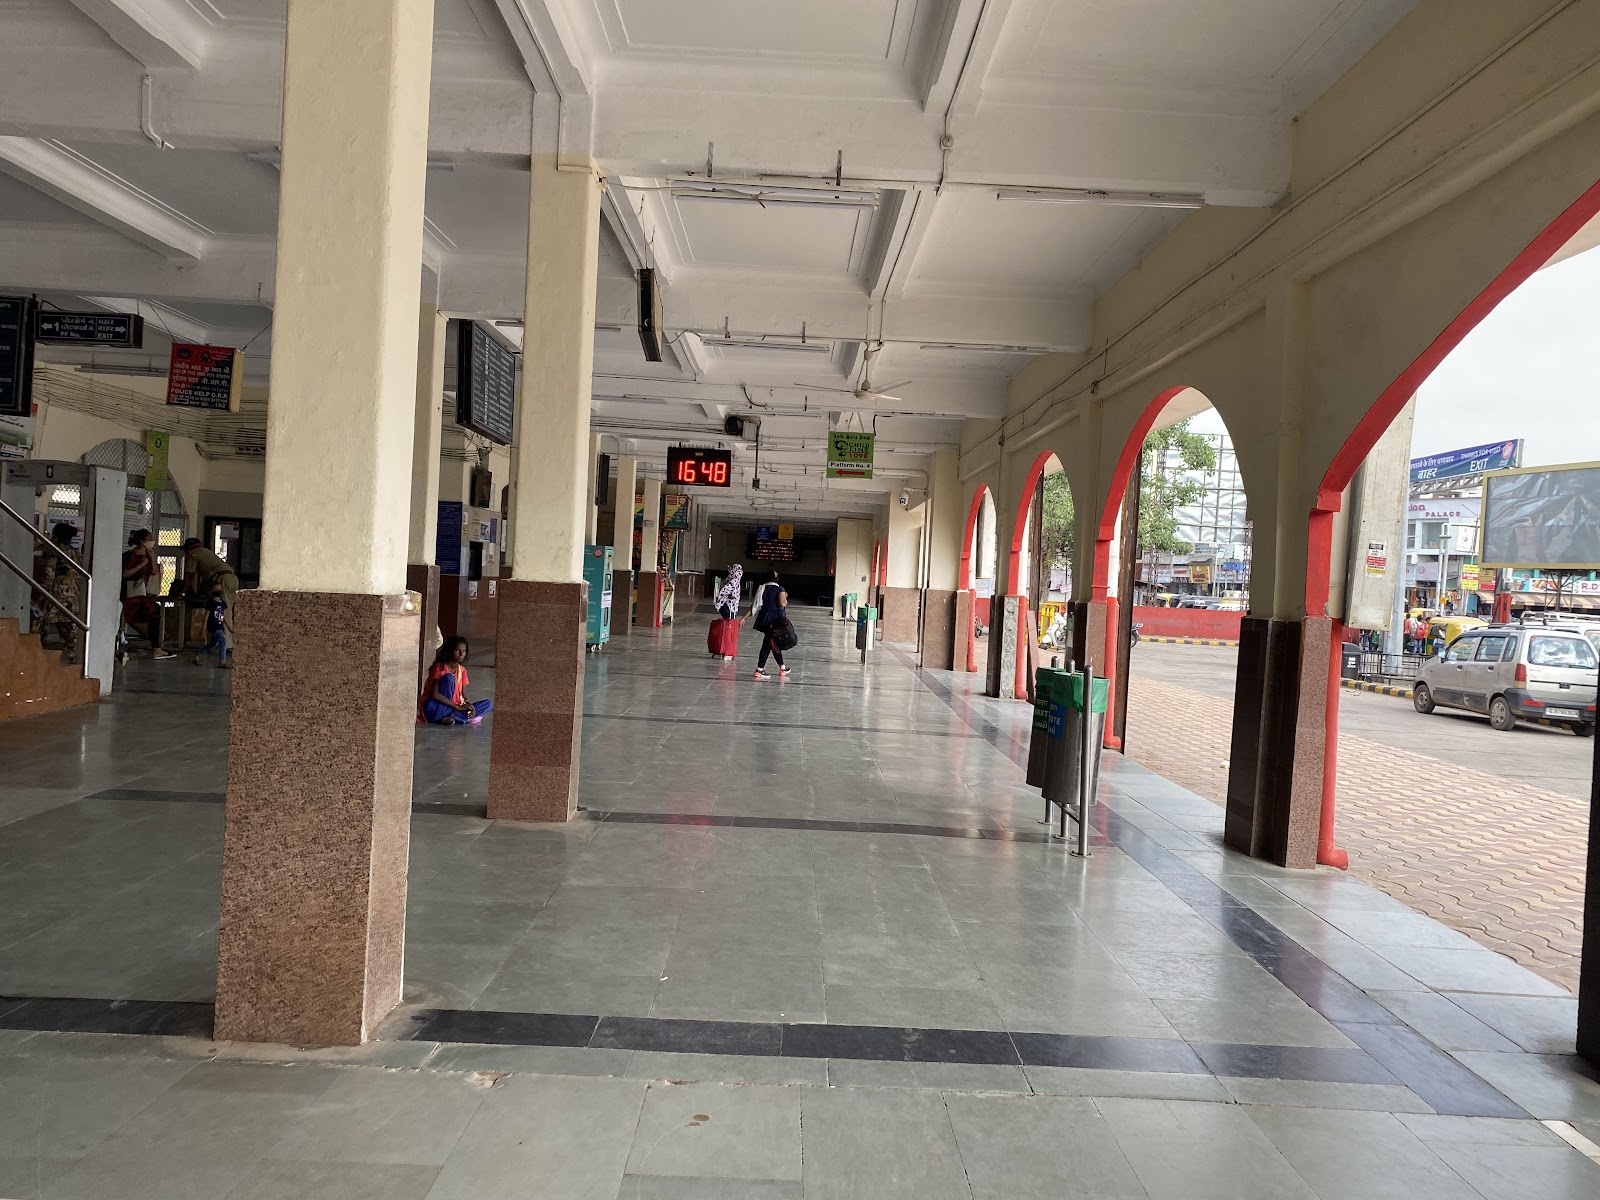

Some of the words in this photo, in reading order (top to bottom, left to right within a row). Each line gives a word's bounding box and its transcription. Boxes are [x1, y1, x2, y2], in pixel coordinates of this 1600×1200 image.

[53, 321, 60, 332] 1
[1470, 458, 1489, 471] EXIT
[1417, 467, 1438, 479] बाहर
